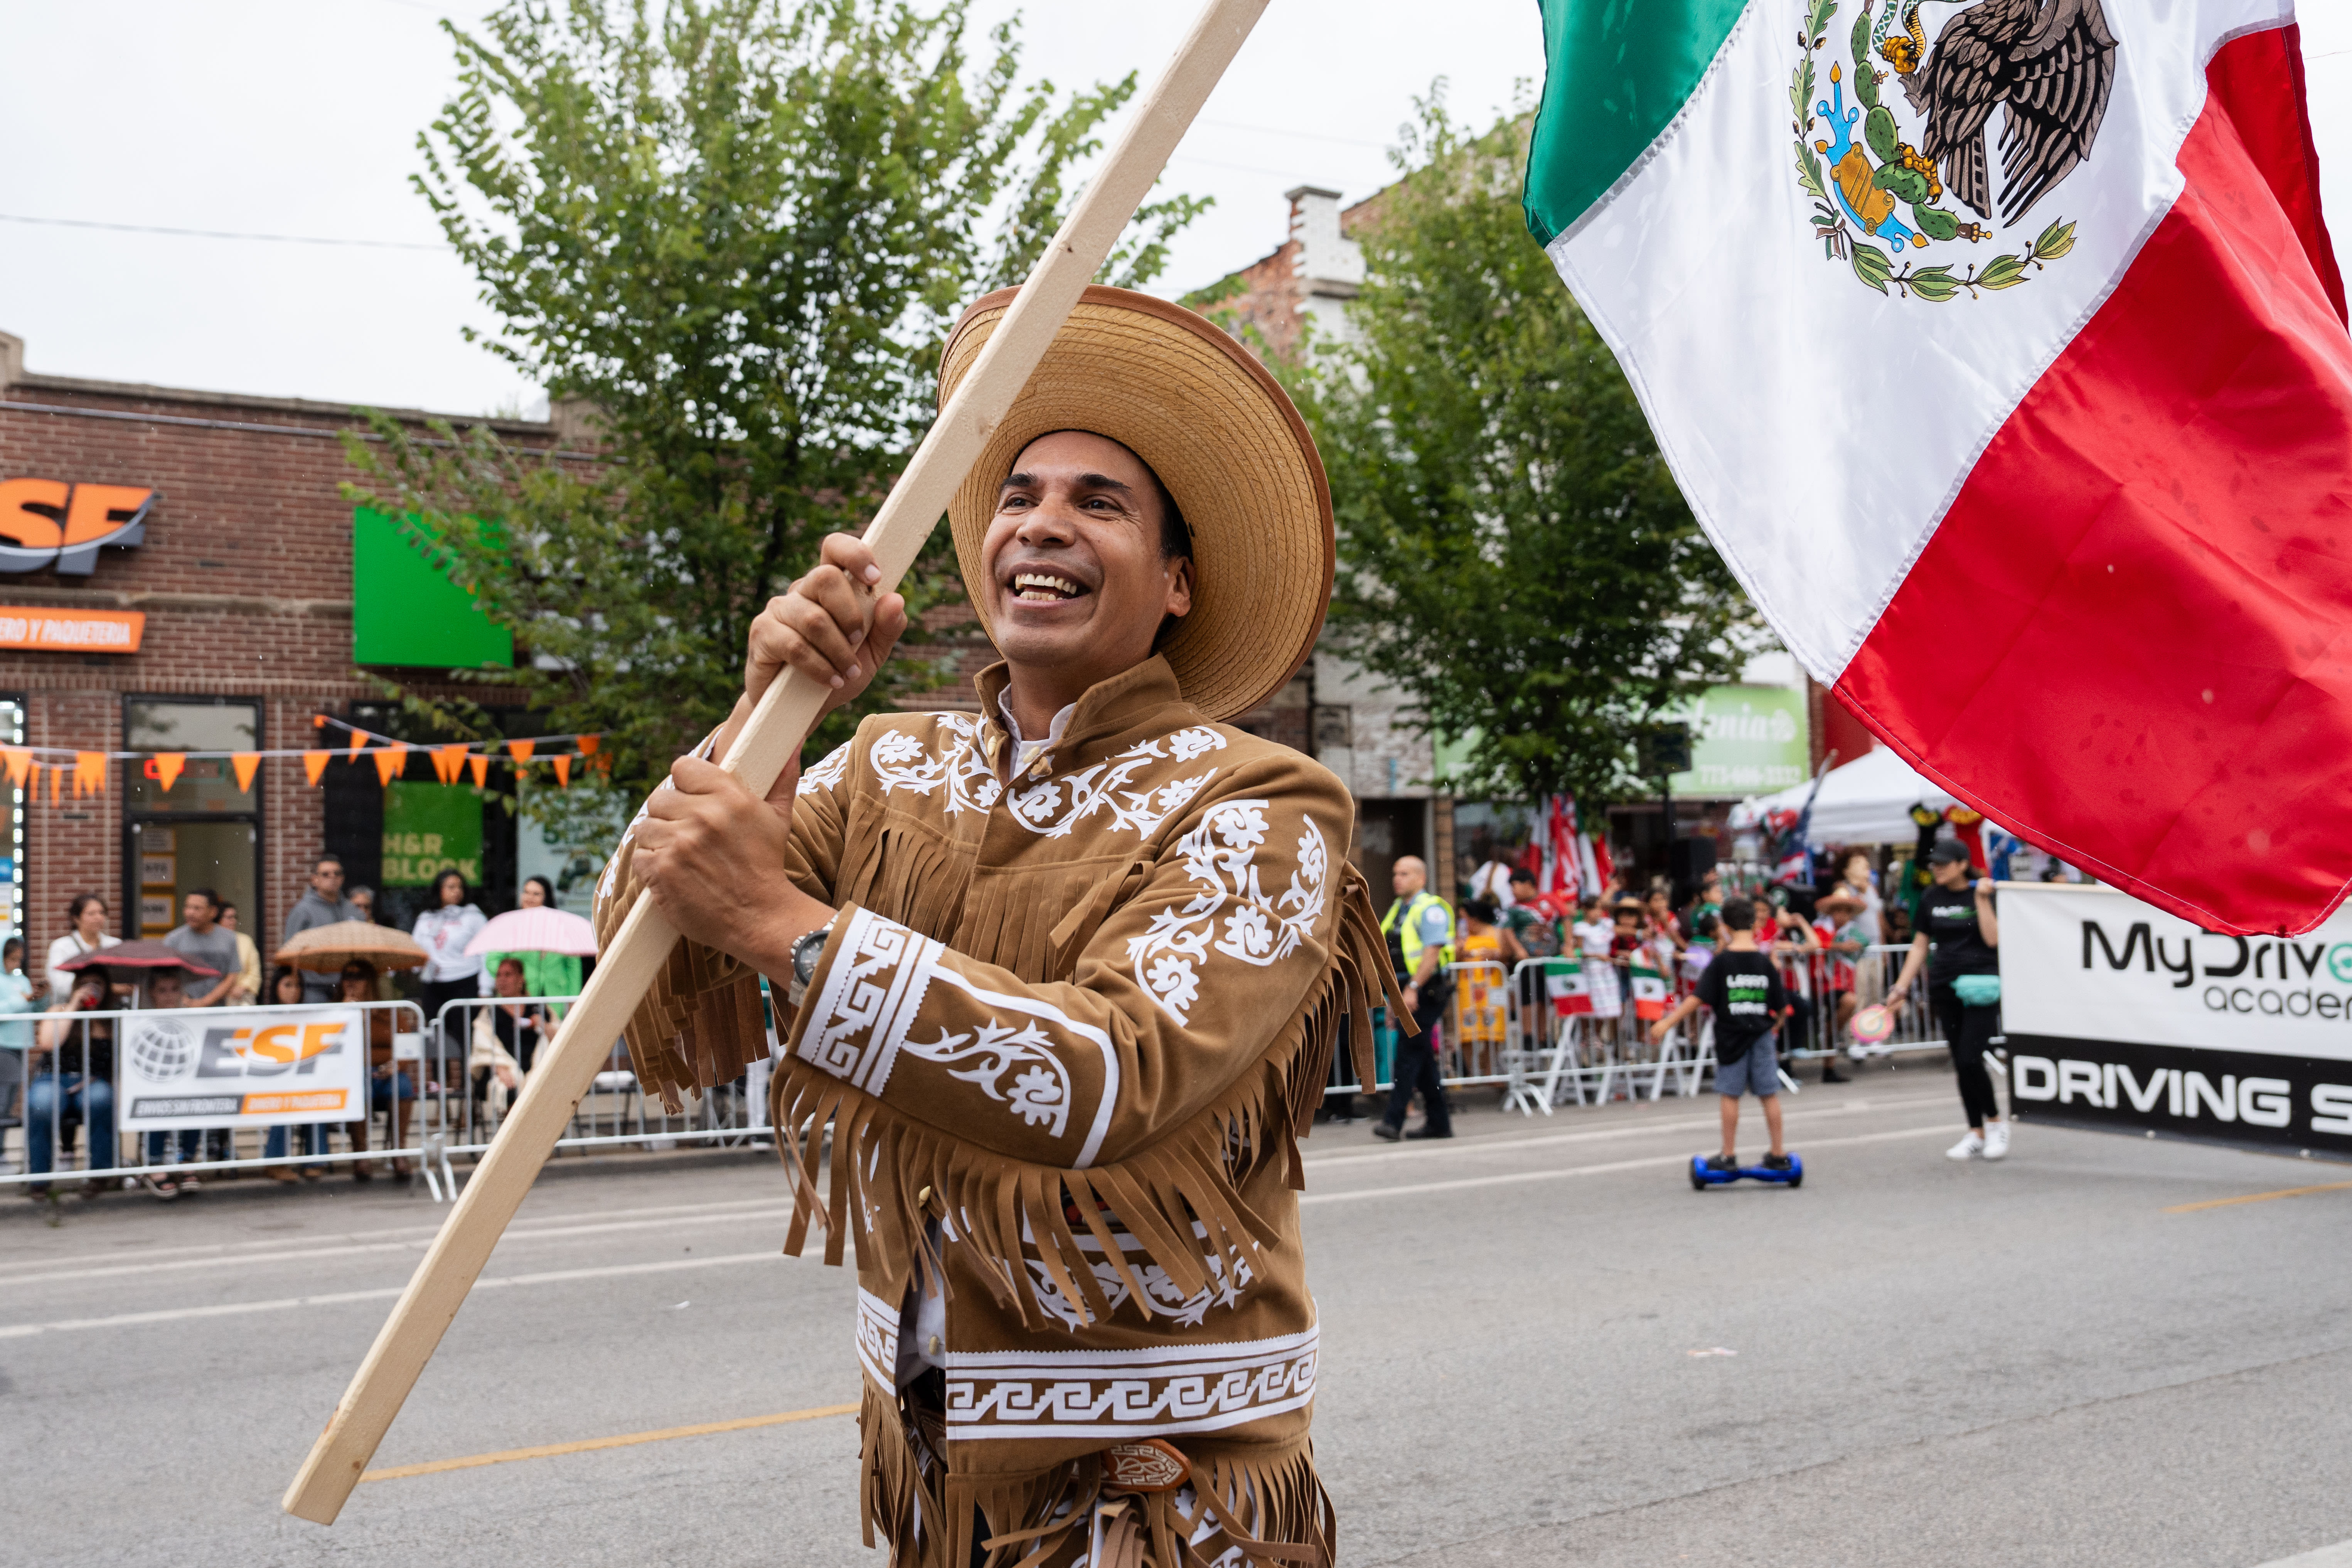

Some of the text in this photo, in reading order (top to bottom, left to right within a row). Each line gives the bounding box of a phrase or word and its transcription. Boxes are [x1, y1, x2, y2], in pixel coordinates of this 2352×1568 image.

[29, 618, 42, 642] Y
[41, 619, 130, 645] PAQUETERIA
[381, 833, 443, 855] H&R
[2204, 986, 2352, 1019] acade
[196, 1023, 347, 1078] ESF
[2013, 1055, 2291, 1128] DRIVING
